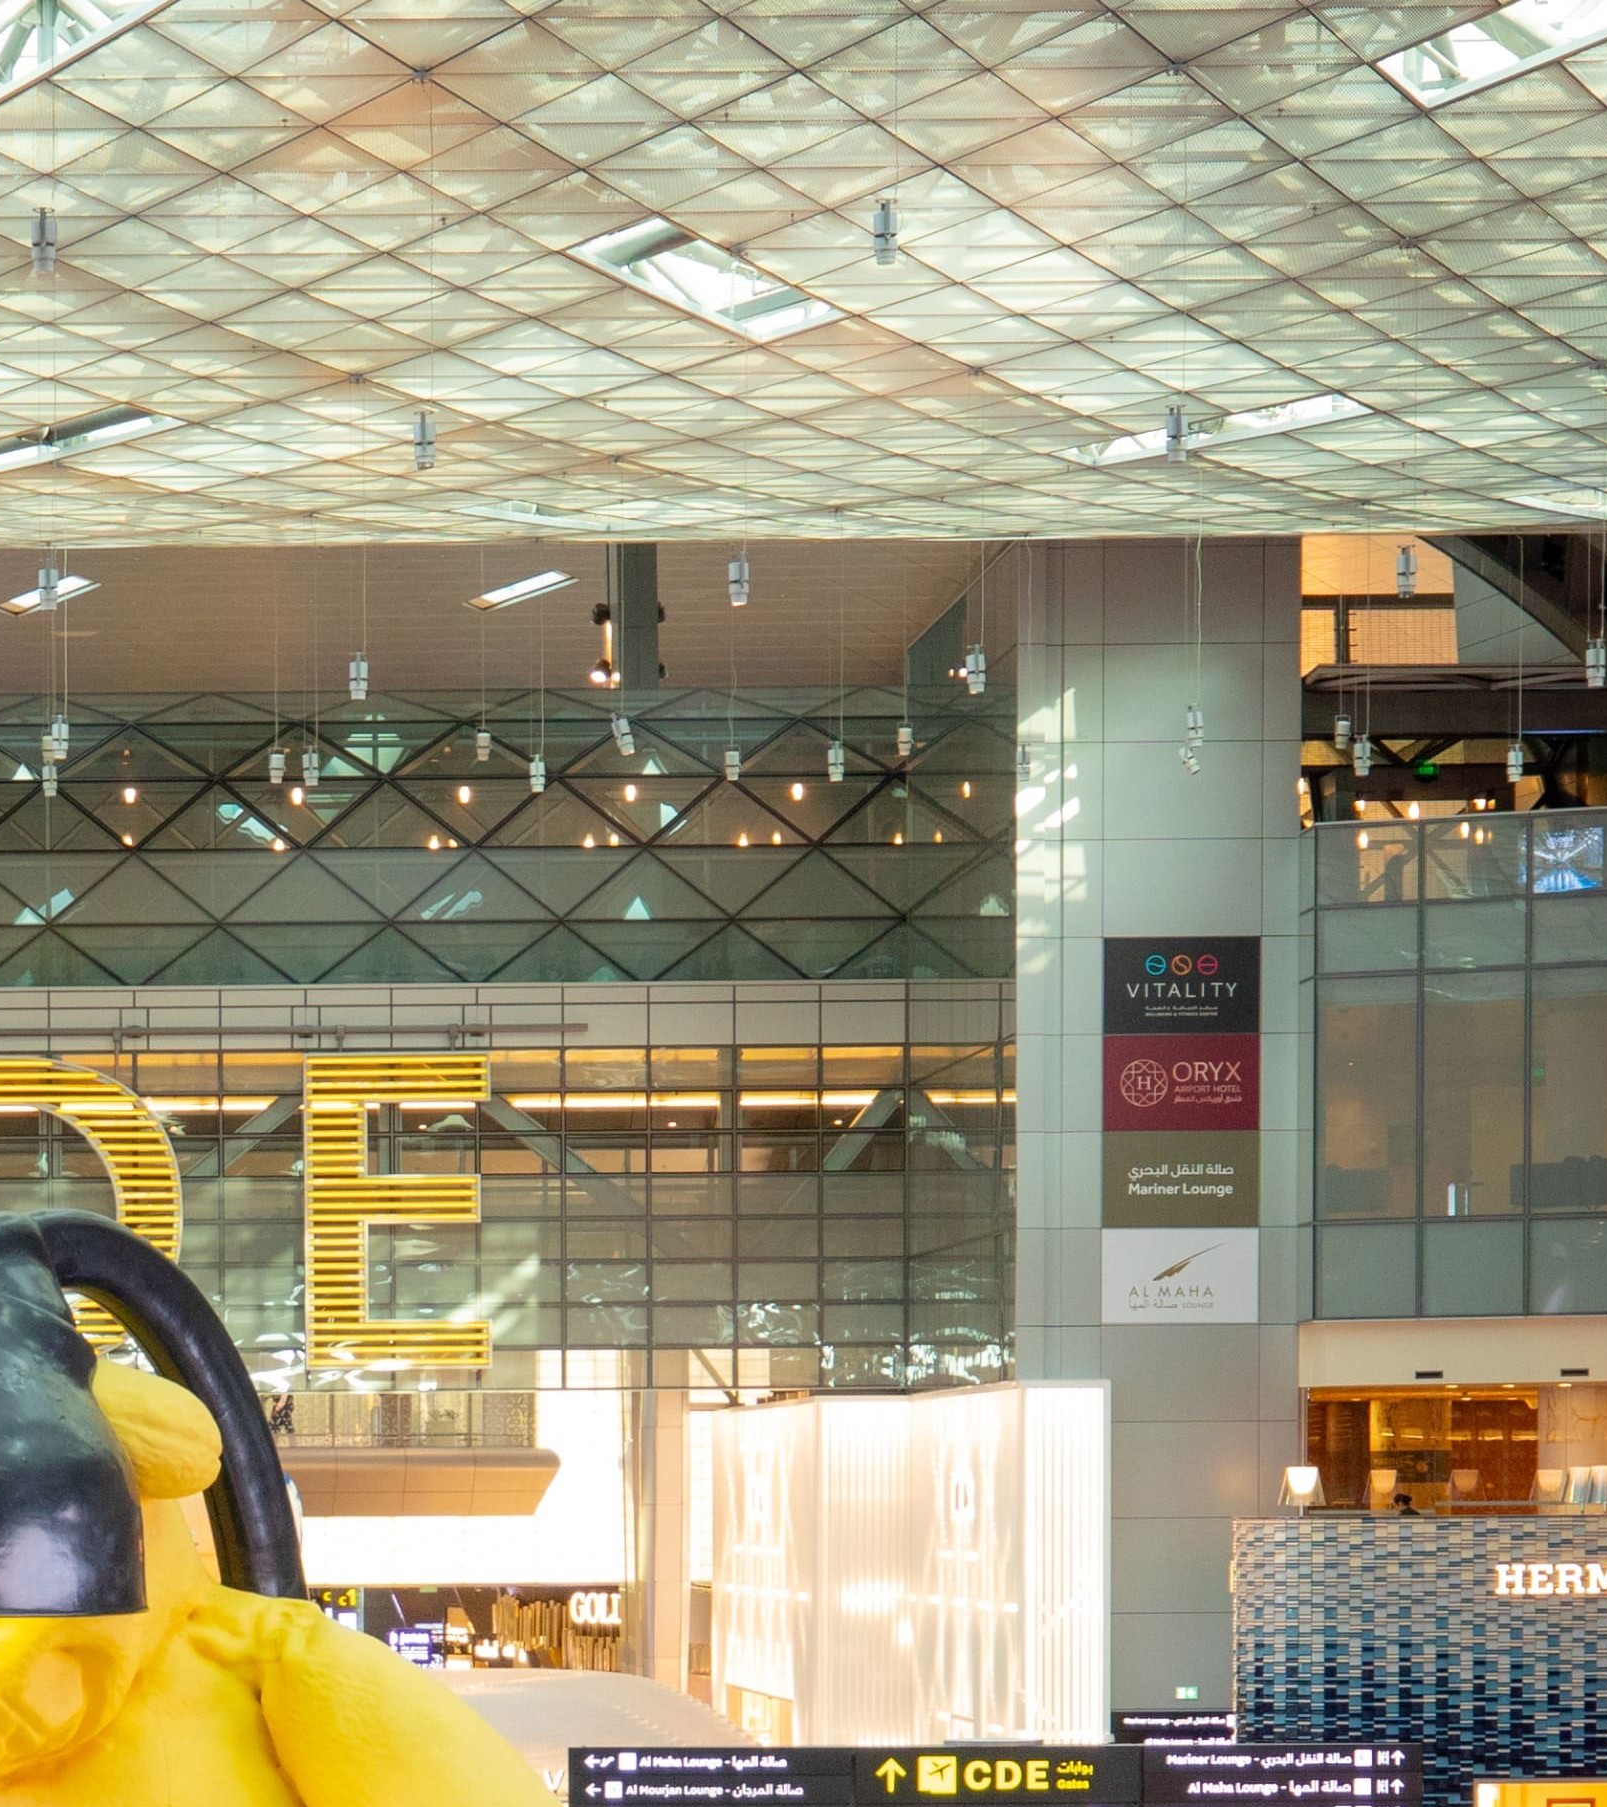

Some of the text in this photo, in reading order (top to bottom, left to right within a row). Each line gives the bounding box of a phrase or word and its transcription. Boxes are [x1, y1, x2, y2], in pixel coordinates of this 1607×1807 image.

[1126, 981, 1238, 999] VITALITY
[1172, 1060, 1242, 1083] ORYX
[1174, 1084, 1241, 1093] AIRPORT HOTEL
[1127, 1163, 1235, 1181] صالة النقل البحري
[1128, 1183, 1234, 1197] Mariner Lounge
[1128, 1286, 1214, 1298] AL MAHA
[639, 1755, 652, 1768] Al
[683, 1755, 723, 1771] Lounge
[1211, 1753, 1252, 1769] Lounge
[1295, 1753, 1323, 1767] النقل
[1325, 1753, 1353, 1765] صالة
[963, 1760, 1050, 1791] CDE
[1056, 1761, 1094, 1776] بوابات
[625, 1782, 724, 1799] Al Mourjan Lounge
[732, 1782, 804, 1799] صالة المرجان
[1056, 1778, 1090, 1790] Gates
[1187, 1780, 1279, 1796] Al Maha Lounge
[1288, 1780, 1352, 1796] صالة المها
